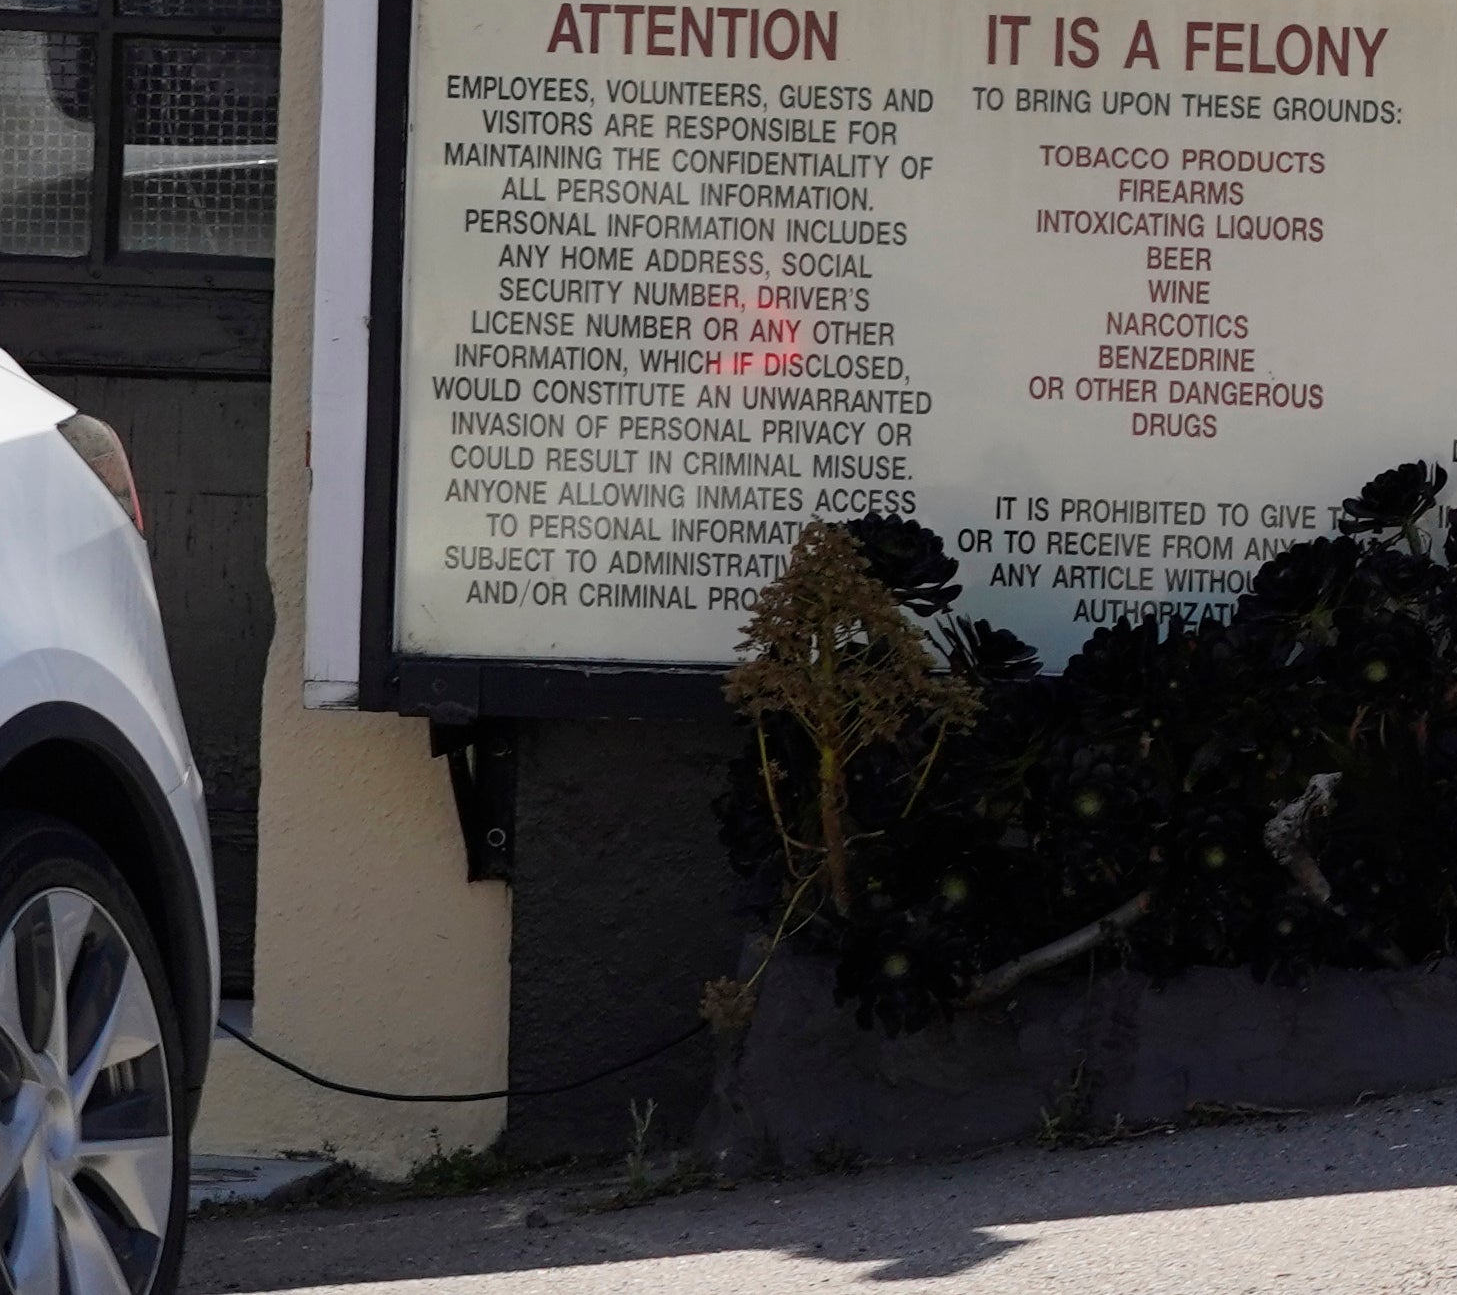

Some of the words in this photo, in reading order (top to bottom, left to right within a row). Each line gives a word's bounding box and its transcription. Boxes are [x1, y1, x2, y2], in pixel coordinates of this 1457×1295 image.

[546, 3, 838, 61] ATTENTION
[988, 15, 1031, 65] IT
[1055, 17, 1099, 68] IS
[1123, 20, 1160, 69] A
[1185, 22, 1389, 77] FELONY
[448, 75, 594, 107] EMPLOYEES,
[607, 80, 767, 112] VOLUNTEERS,
[780, 84, 872, 111] GUESTS
[883, 88, 933, 112] AND
[973, 87, 1004, 111] TO
[1016, 88, 1091, 113] BRING
[1103, 91, 1170, 116] UPON
[1182, 94, 1261, 119] THESE
[1273, 97, 1401, 124] GROUNDS:
[482, 110, 592, 136] VISITORS
[604, 114, 654, 137] ARE
[666, 115, 836, 143] RESPONSIBLE
[849, 121, 897, 145] FOR
[445, 142, 601, 170] MAINTAINING
[613, 147, 660, 171] THE
[672, 149, 889, 178] CONFIDENTIALITY
[901, 156, 933, 180] OF
[1040, 145, 1169, 169] TOBACCO
[1183, 149, 1325, 174] PRODUCTS
[502, 177, 546, 201] ALL
[558, 179, 689, 205] PERSONAL
[701, 183, 873, 211] INFORMATION.
[1119, 179, 1243, 206] FIREARMS
[465, 209, 596, 236] PERSONAL
[608, 214, 774, 241] INFORMATION
[787, 219, 907, 246] INCLUDES
[1037, 209, 1204, 238] INTOXICATING
[1216, 215, 1323, 242] LIQUORS
[498, 244, 550, 268] ANY
[562, 246, 633, 271] HOME
[645, 249, 769, 279] ADDRESS,
[782, 252, 872, 278] SOCIAL
[1147, 246, 1211, 271] BEER
[500, 277, 623, 304] SECURITY
[634, 282, 745, 312] NUMBER,
[758, 285, 869, 312] DRIVER'S
[1148, 280, 1210, 304] WINE
[472, 310, 574, 336] LICENSE
[587, 313, 691, 340] NUMBER
[704, 317, 738, 341] OR
[749, 319, 801, 343] ANY
[813, 320, 894, 346] OTHER
[1107, 312, 1248, 339] NARCOTICS
[456, 344, 627, 377] INFORMATION,
[640, 349, 721, 375] WHICH
[734, 352, 754, 375] IF
[765, 353, 909, 385] DISCLOSED,
[1099, 345, 1255, 372] BENZEDRINE
[432, 377, 521, 402] WOULD
[533, 379, 685, 407] CONSTITUTE
[697, 385, 730, 408] AN
[743, 386, 932, 414] UNWARRANTED
[1029, 376, 1063, 399] OR
[1076, 377, 1156, 402] OTHER
[1169, 381, 1323, 409] DANGEROUS
[452, 411, 563, 437] INVASION
[577, 415, 608, 438] OF
[620, 416, 751, 442] PERSONAL
[763, 420, 865, 445] PRIVACY
[878, 422, 911, 446] OR
[1132, 412, 1217, 438] DRUGS
[451, 445, 534, 470] COULD
[547, 448, 638, 473] RESULT
[650, 451, 671, 474] IN
[684, 452, 801, 477] CRIMINAL
[813, 455, 912, 480] MISUSE.
[445, 479, 546, 504] ANYONE
[559, 482, 684, 508] ALLOWING
[698, 486, 802, 511] INMATES
[814, 489, 916, 515] ACCESS
[996, 496, 1017, 520] IT
[1028, 497, 1049, 521] IS
[1061, 498, 1206, 525] PROHIBITED
[1217, 503, 1248, 527] TO
[1261, 504, 1316, 529] GIVE
[486, 513, 517, 537] TO
[530, 515, 661, 541] PERSONAL
[958, 528, 992, 553] OR
[1003, 530, 1035, 554] TO
[1047, 531, 1150, 557] RECEIVE
[1163, 535, 1233, 559] FROM
[445, 546, 555, 571] SUBJECT
[566, 549, 596, 573] TO
[989, 563, 1041, 587] ANY
[1052, 565, 1153, 590] ARTICLE
[466, 580, 567, 607] AND/OR
[579, 583, 697, 609] CRIMINAL
